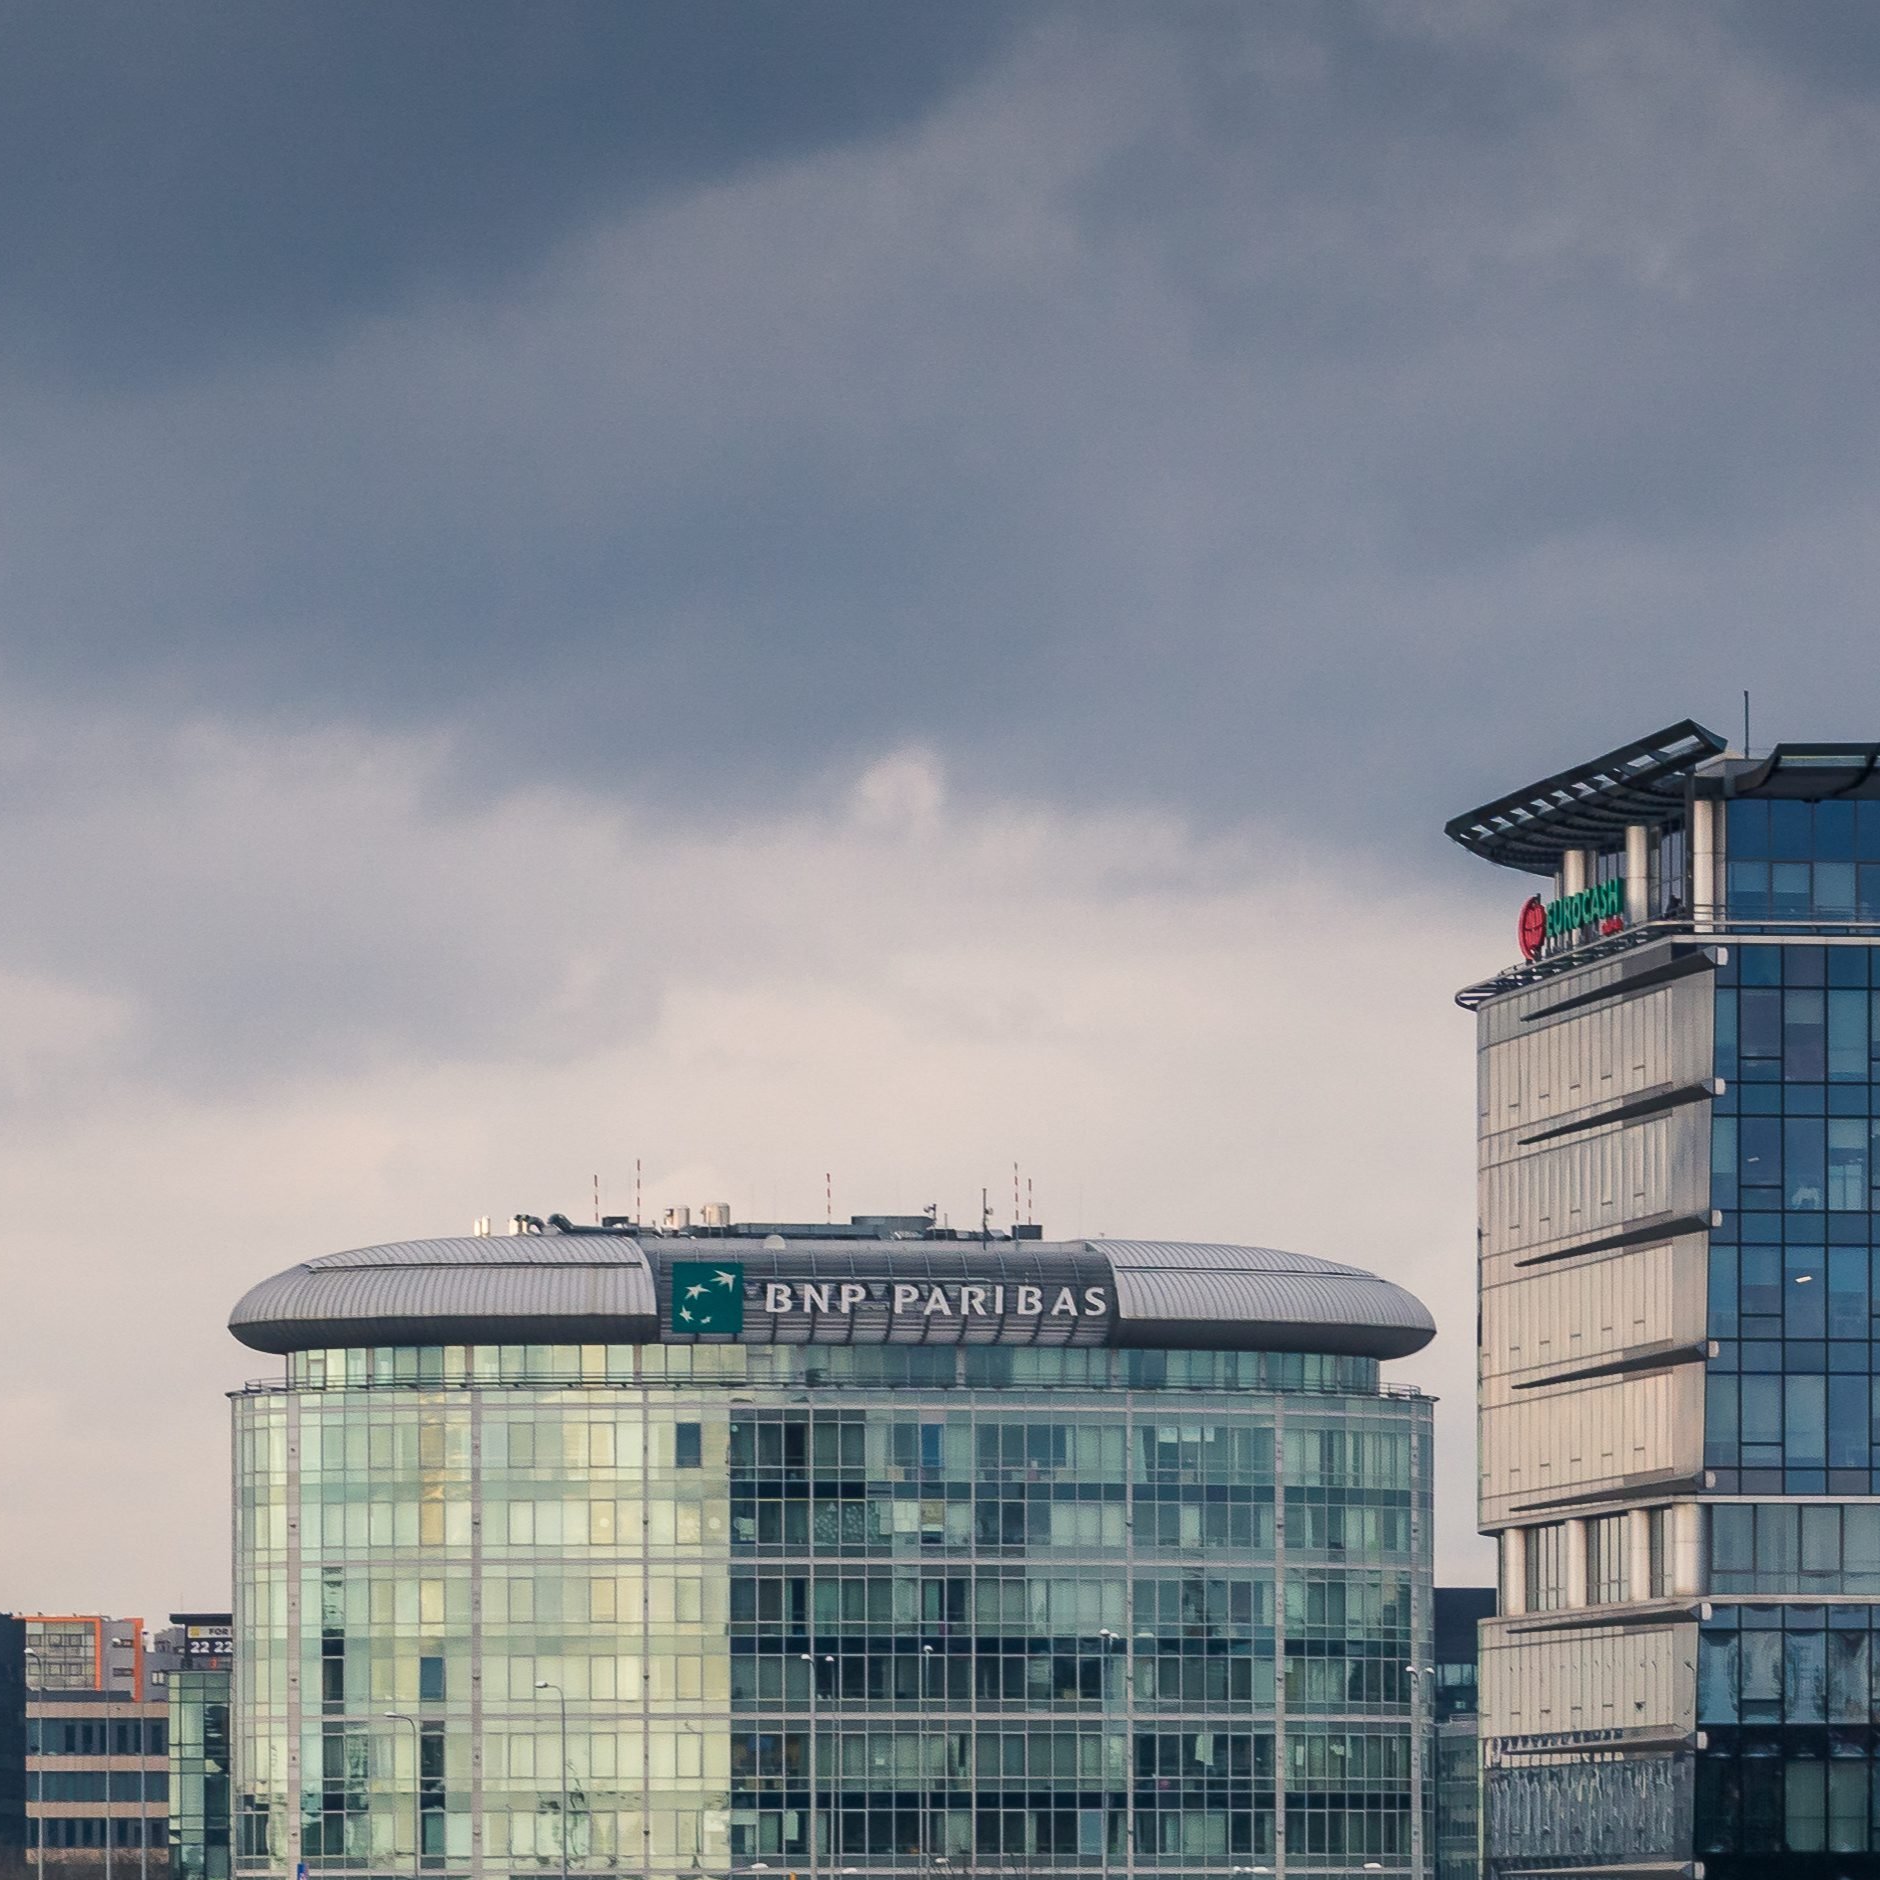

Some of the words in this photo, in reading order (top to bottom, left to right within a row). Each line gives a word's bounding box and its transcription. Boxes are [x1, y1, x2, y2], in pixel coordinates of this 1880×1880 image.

[1546, 877, 1624, 938] EUROCASH
[764, 1282, 868, 1315] BNP
[892, 1283, 1107, 1317] PARIBAS
[190, 1641, 210, 1654] 22
[214, 1641, 233, 1654] 22
